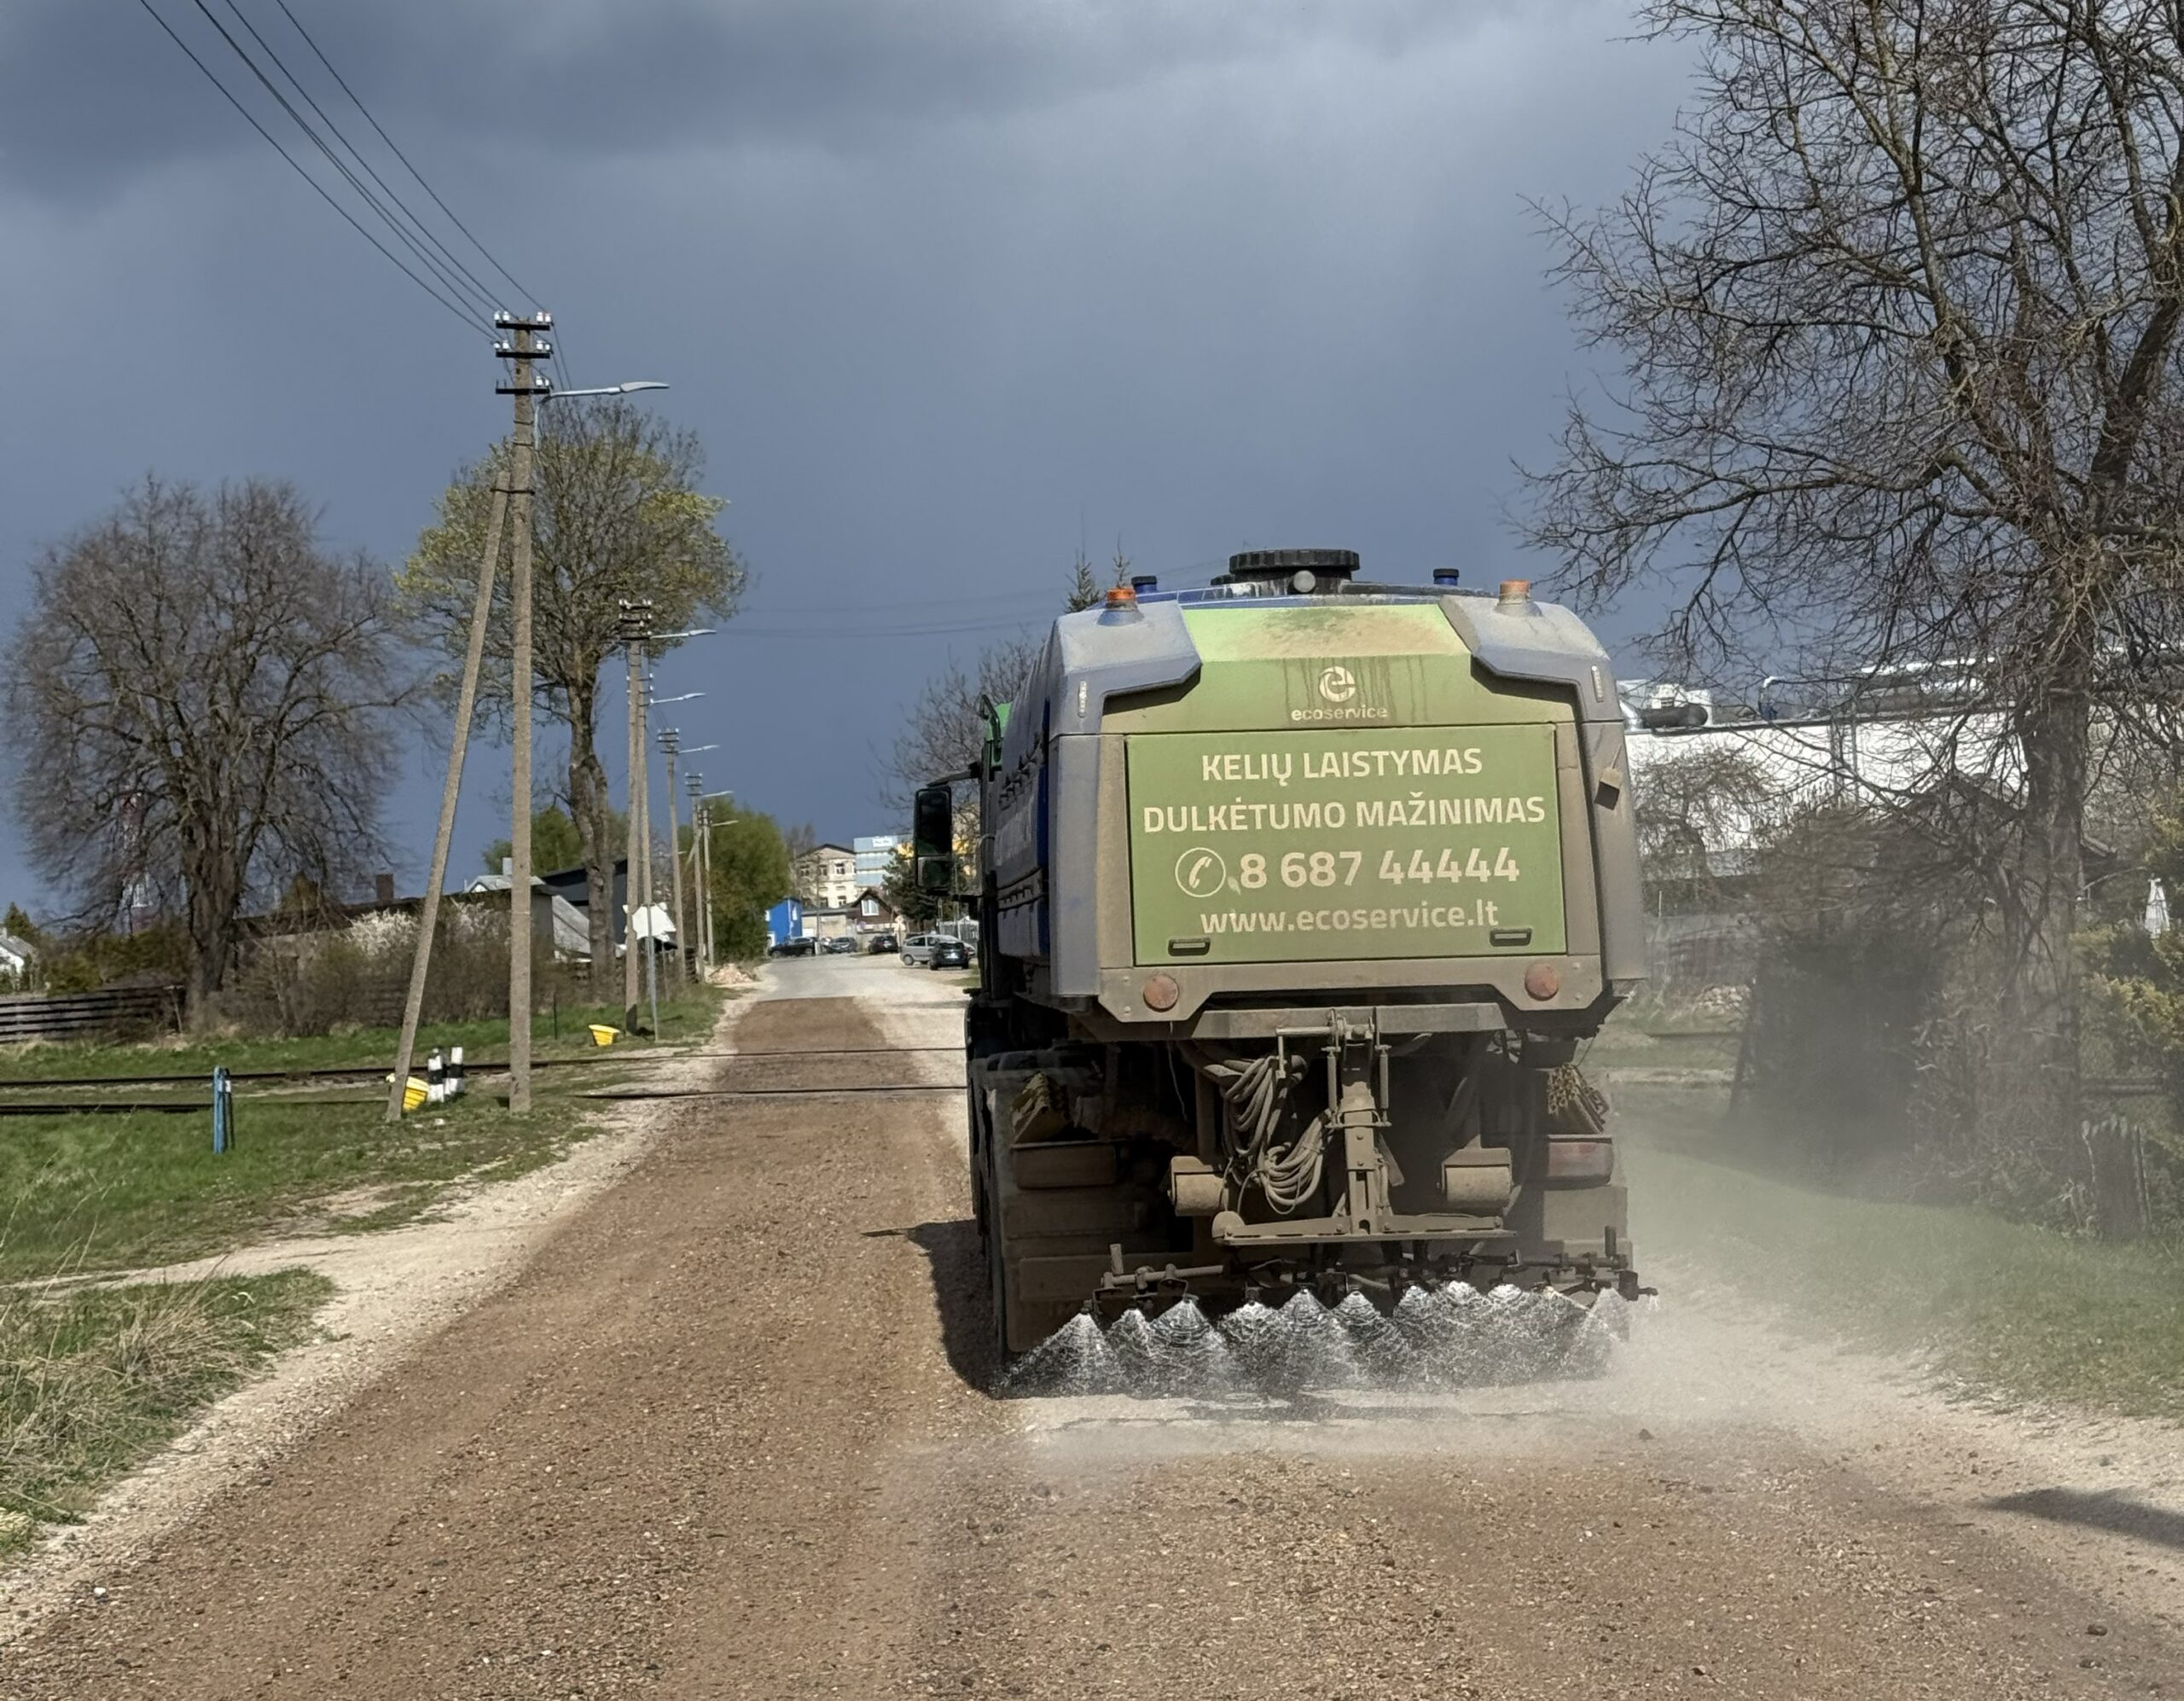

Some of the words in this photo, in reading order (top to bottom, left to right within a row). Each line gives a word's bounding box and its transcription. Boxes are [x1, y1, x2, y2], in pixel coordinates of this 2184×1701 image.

[1291, 705, 1388, 721] ecoservice
[1202, 753, 1292, 787] KELIŲ
[1303, 748, 1483, 779] LAISTYMAS
[1143, 797, 1346, 833] DULKĖTUMO
[1356, 792, 1545, 827] MAŽINIMAS
[1240, 853, 1268, 889] 8
[1281, 850, 1362, 888] 687
[1379, 846, 1520, 885] 44444
[1199, 899, 1499, 934] www.ecoservice.lt
